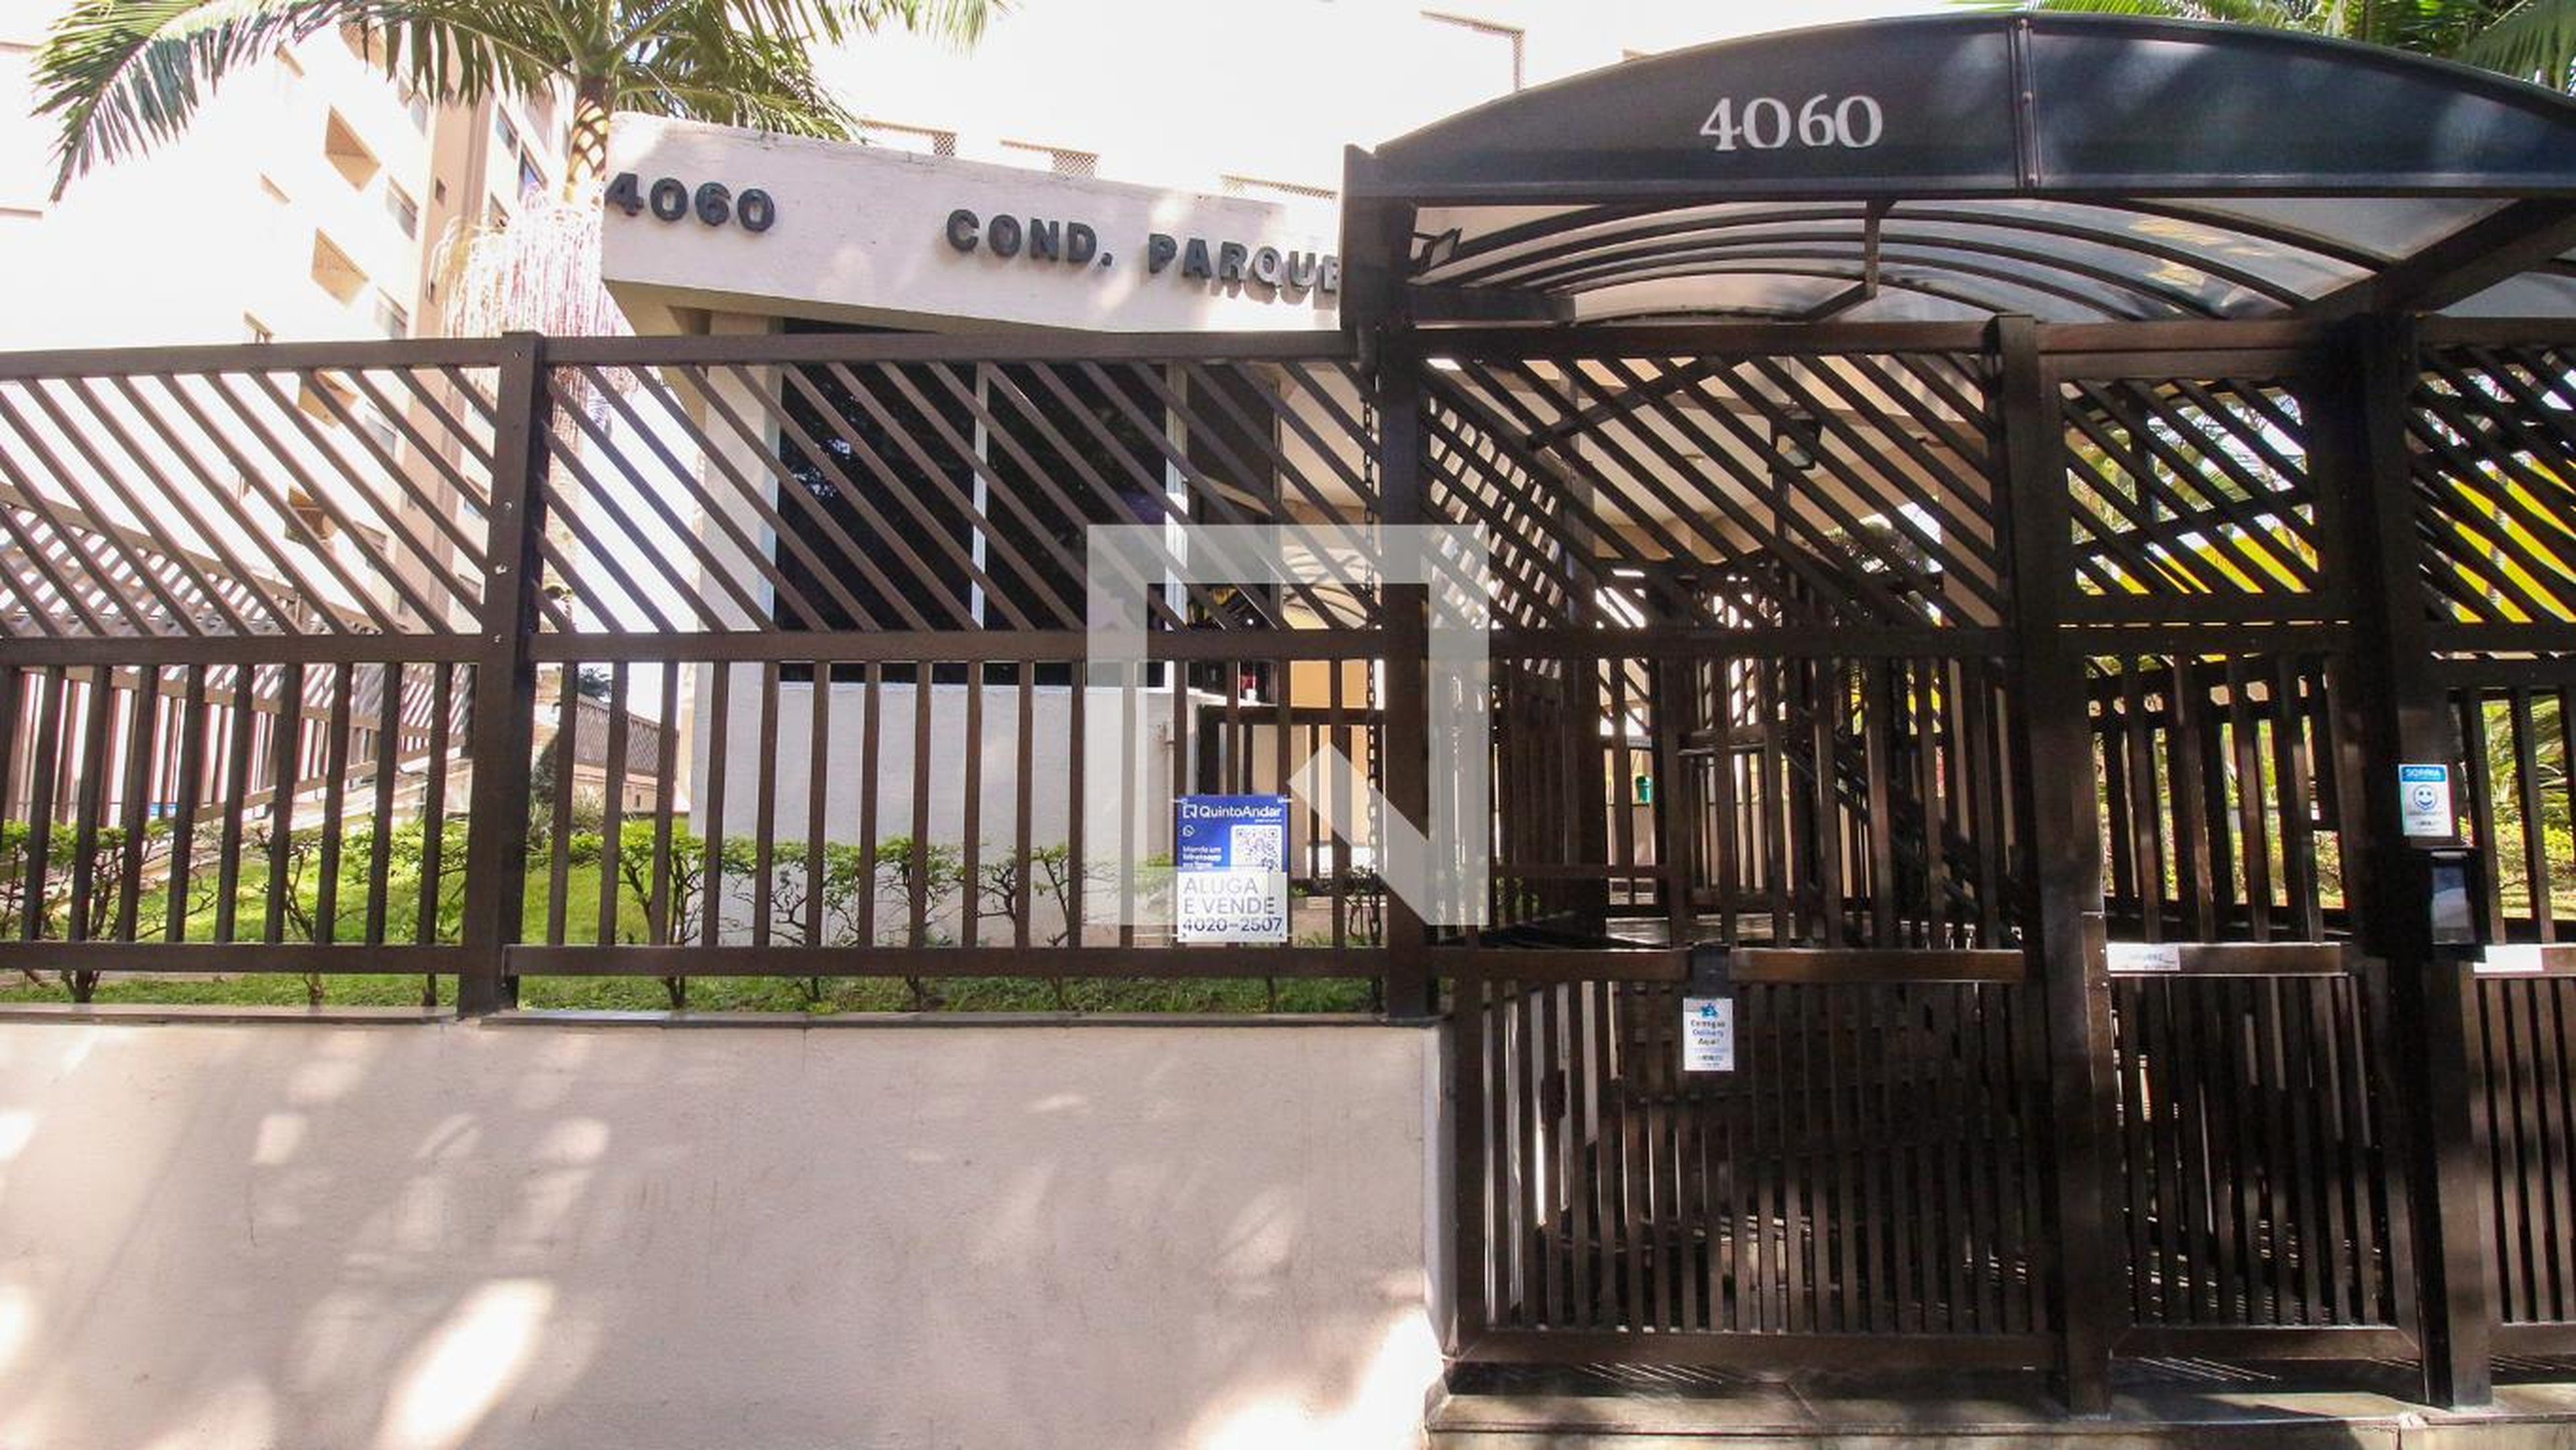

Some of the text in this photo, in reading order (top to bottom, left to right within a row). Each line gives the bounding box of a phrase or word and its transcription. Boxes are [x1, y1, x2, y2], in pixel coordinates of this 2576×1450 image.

[1700, 93, 1883, 151] 4060
[604, 171, 775, 233] 4060
[946, 209, 1342, 293] COND. PARQUE
[1199, 805, 1283, 818] QuintoAndar
[1183, 878, 1258, 894] ALUGA
[1185, 896, 1275, 915] E VENDE
[1183, 917, 1283, 932] 4020-2507
